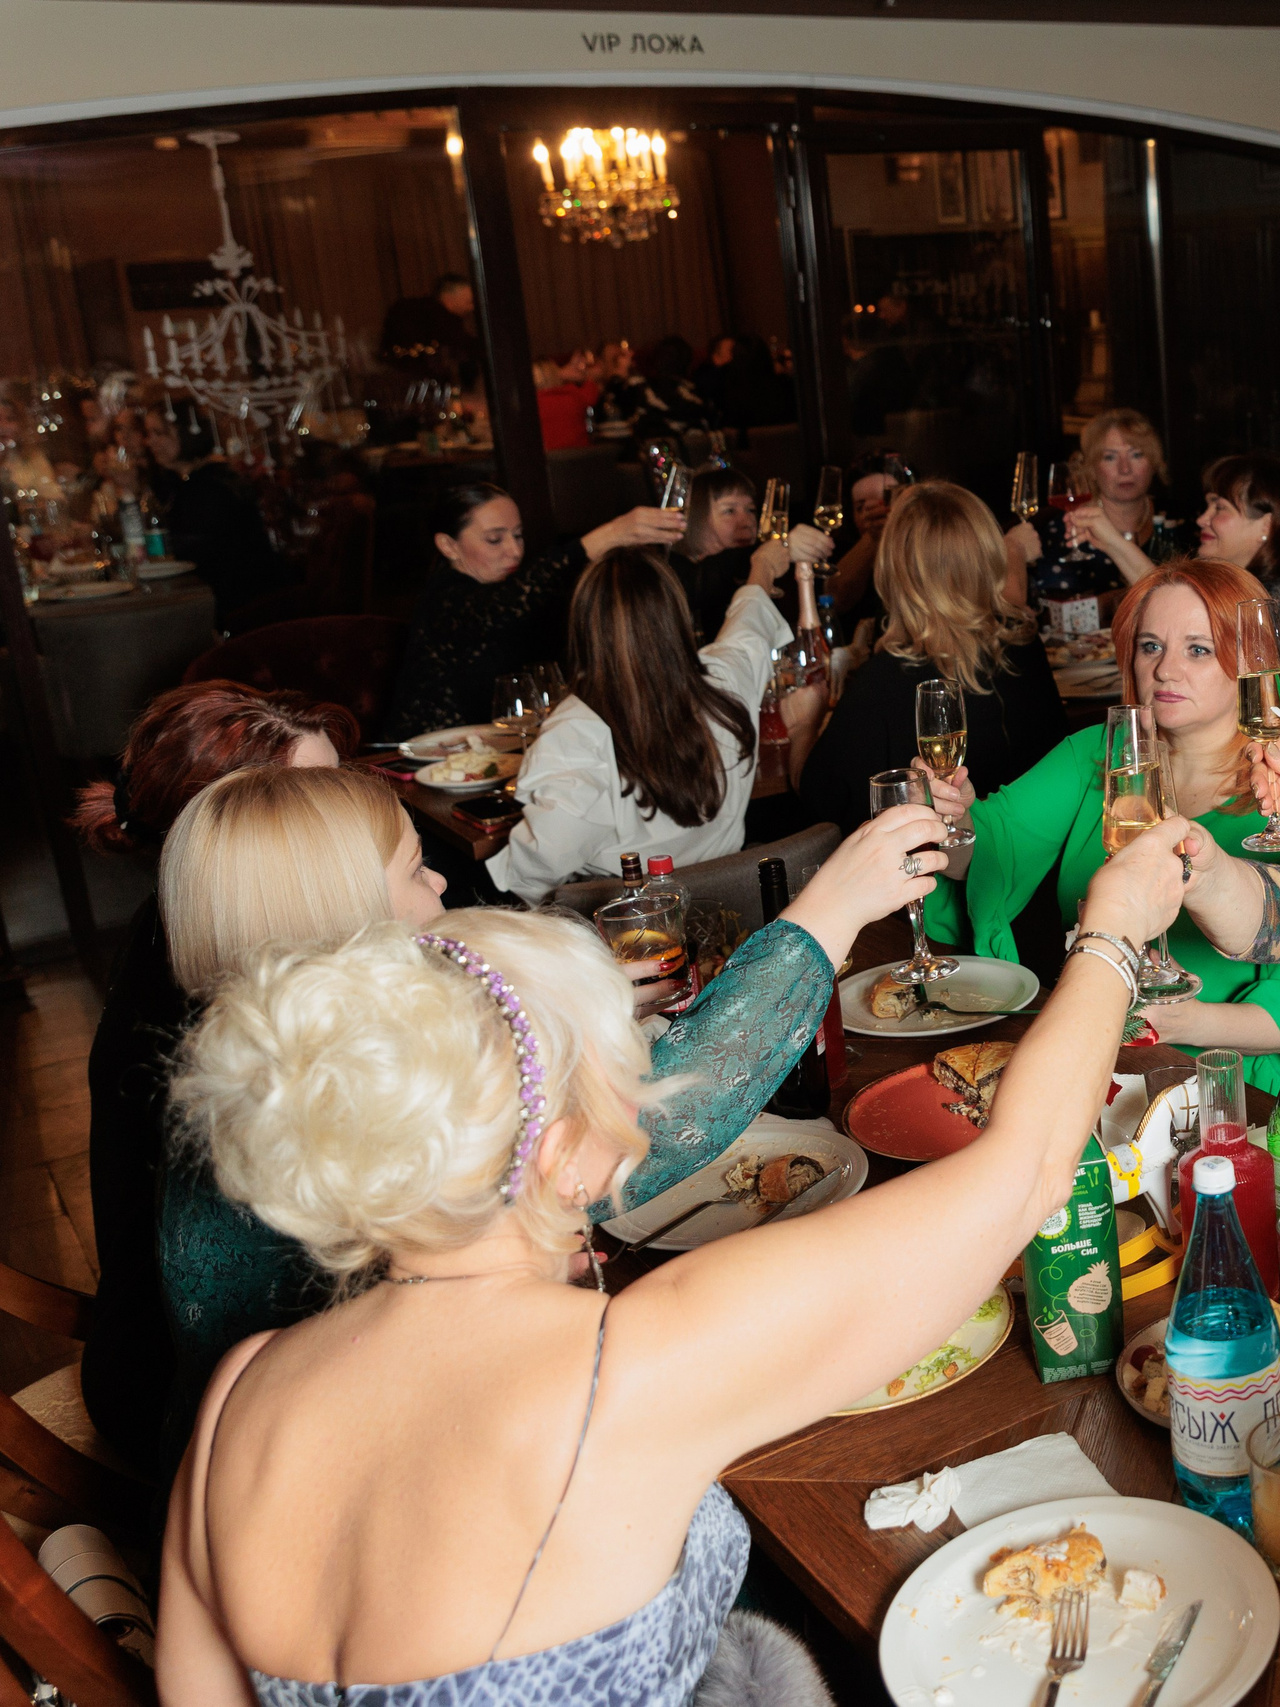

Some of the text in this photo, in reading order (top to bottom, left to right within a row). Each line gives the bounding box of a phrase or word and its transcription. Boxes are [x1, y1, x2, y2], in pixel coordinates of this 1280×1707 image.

[581, 32, 705, 54] VIP ЛОЖА
[1051, 1239, 1092, 1254] БОЛЬШЕ
[1081, 1247, 1098, 1256] СИЛ
